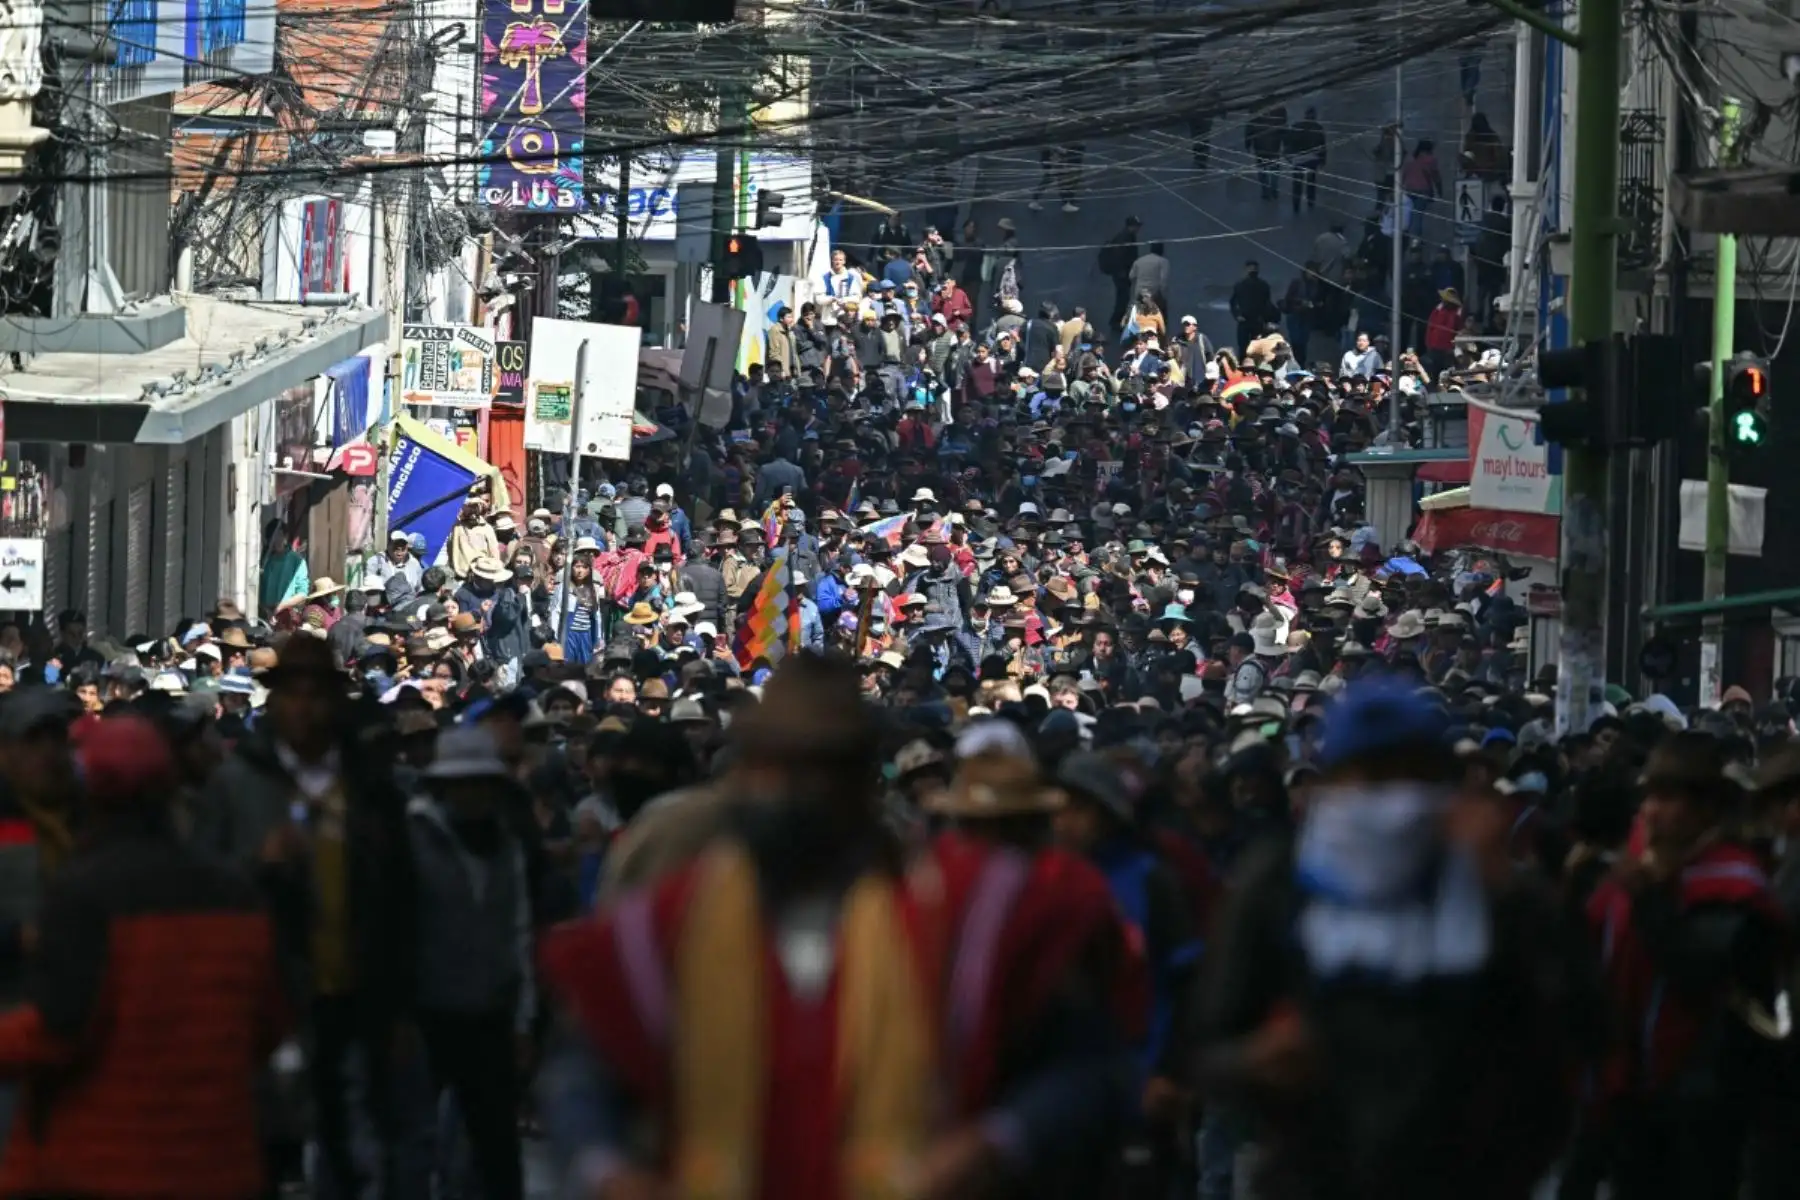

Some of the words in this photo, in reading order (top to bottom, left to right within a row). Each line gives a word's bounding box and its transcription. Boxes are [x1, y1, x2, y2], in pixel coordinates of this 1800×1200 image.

[485, 180, 577, 208] CLUB
[404, 328, 453, 340] ZARA
[1482, 456, 1512, 481] mayl
[1515, 459, 1547, 479] tours
